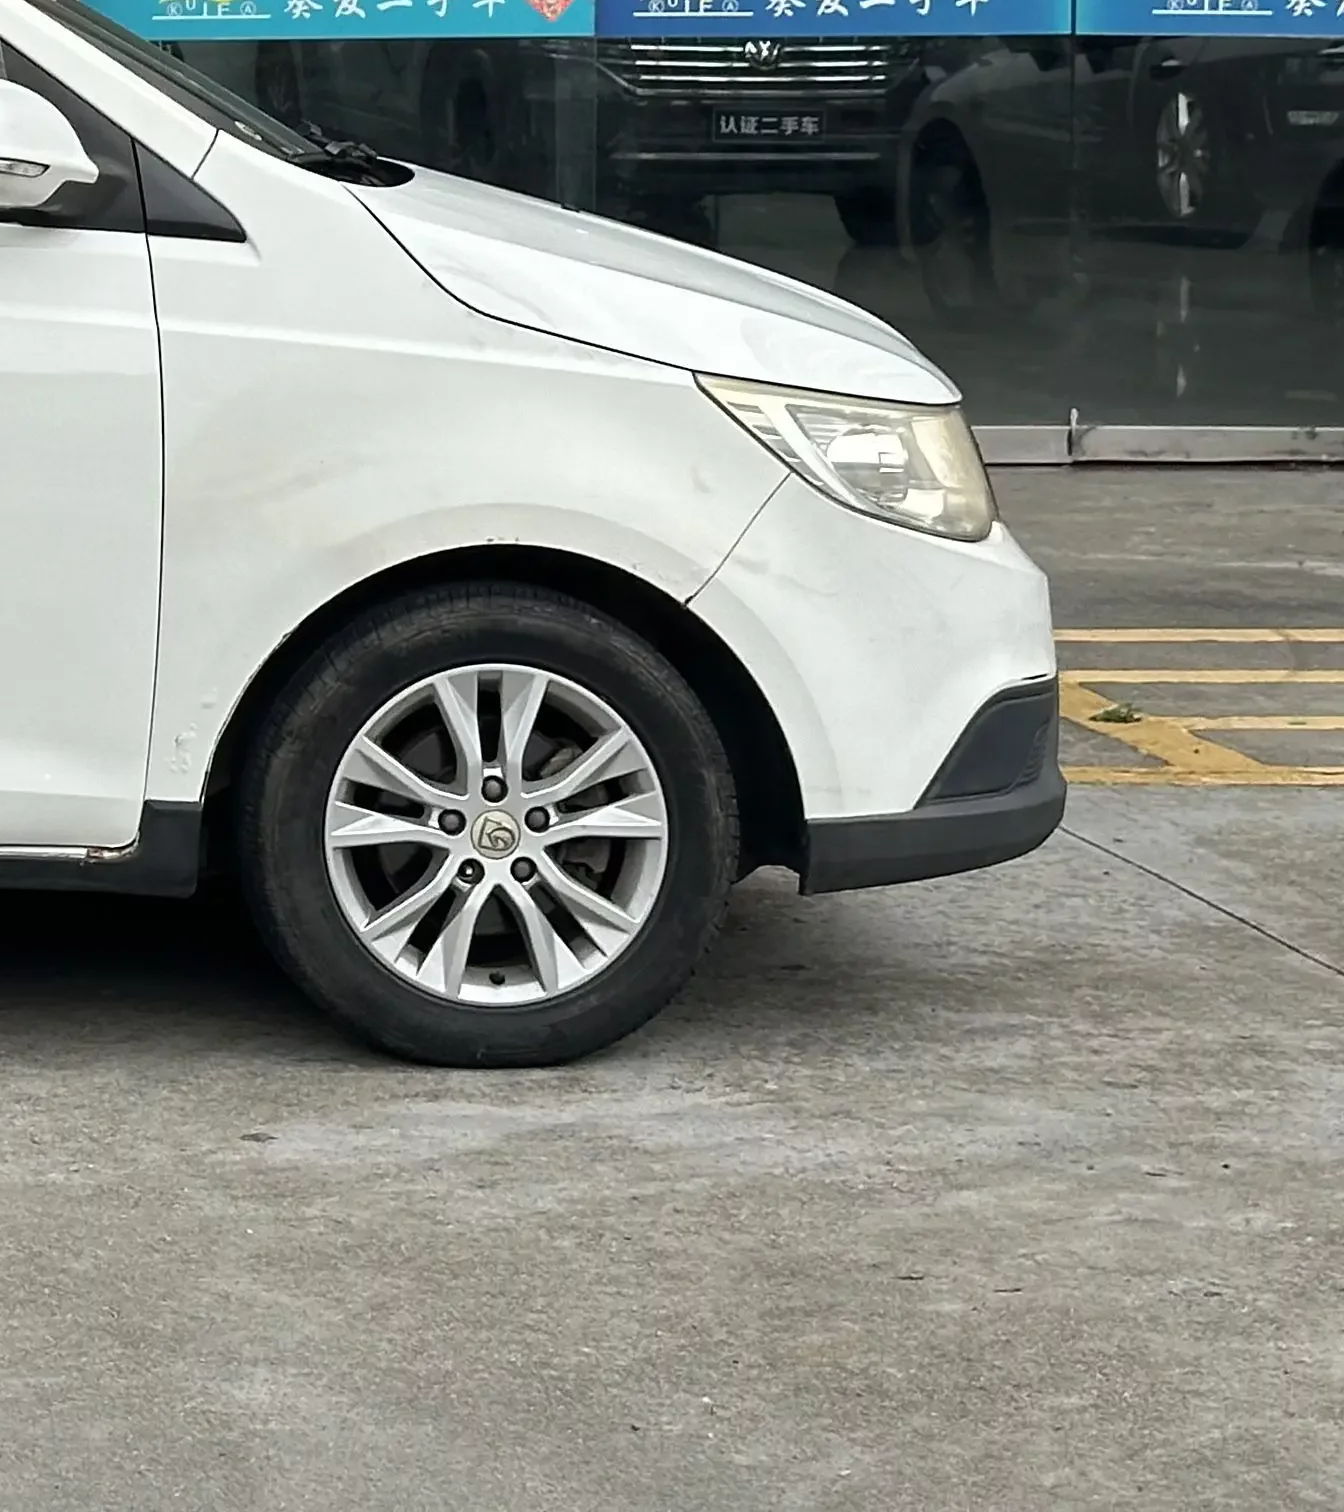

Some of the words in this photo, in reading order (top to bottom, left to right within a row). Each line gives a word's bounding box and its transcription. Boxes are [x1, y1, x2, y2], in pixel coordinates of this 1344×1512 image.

[719, 115, 820, 136] 认证二手车
